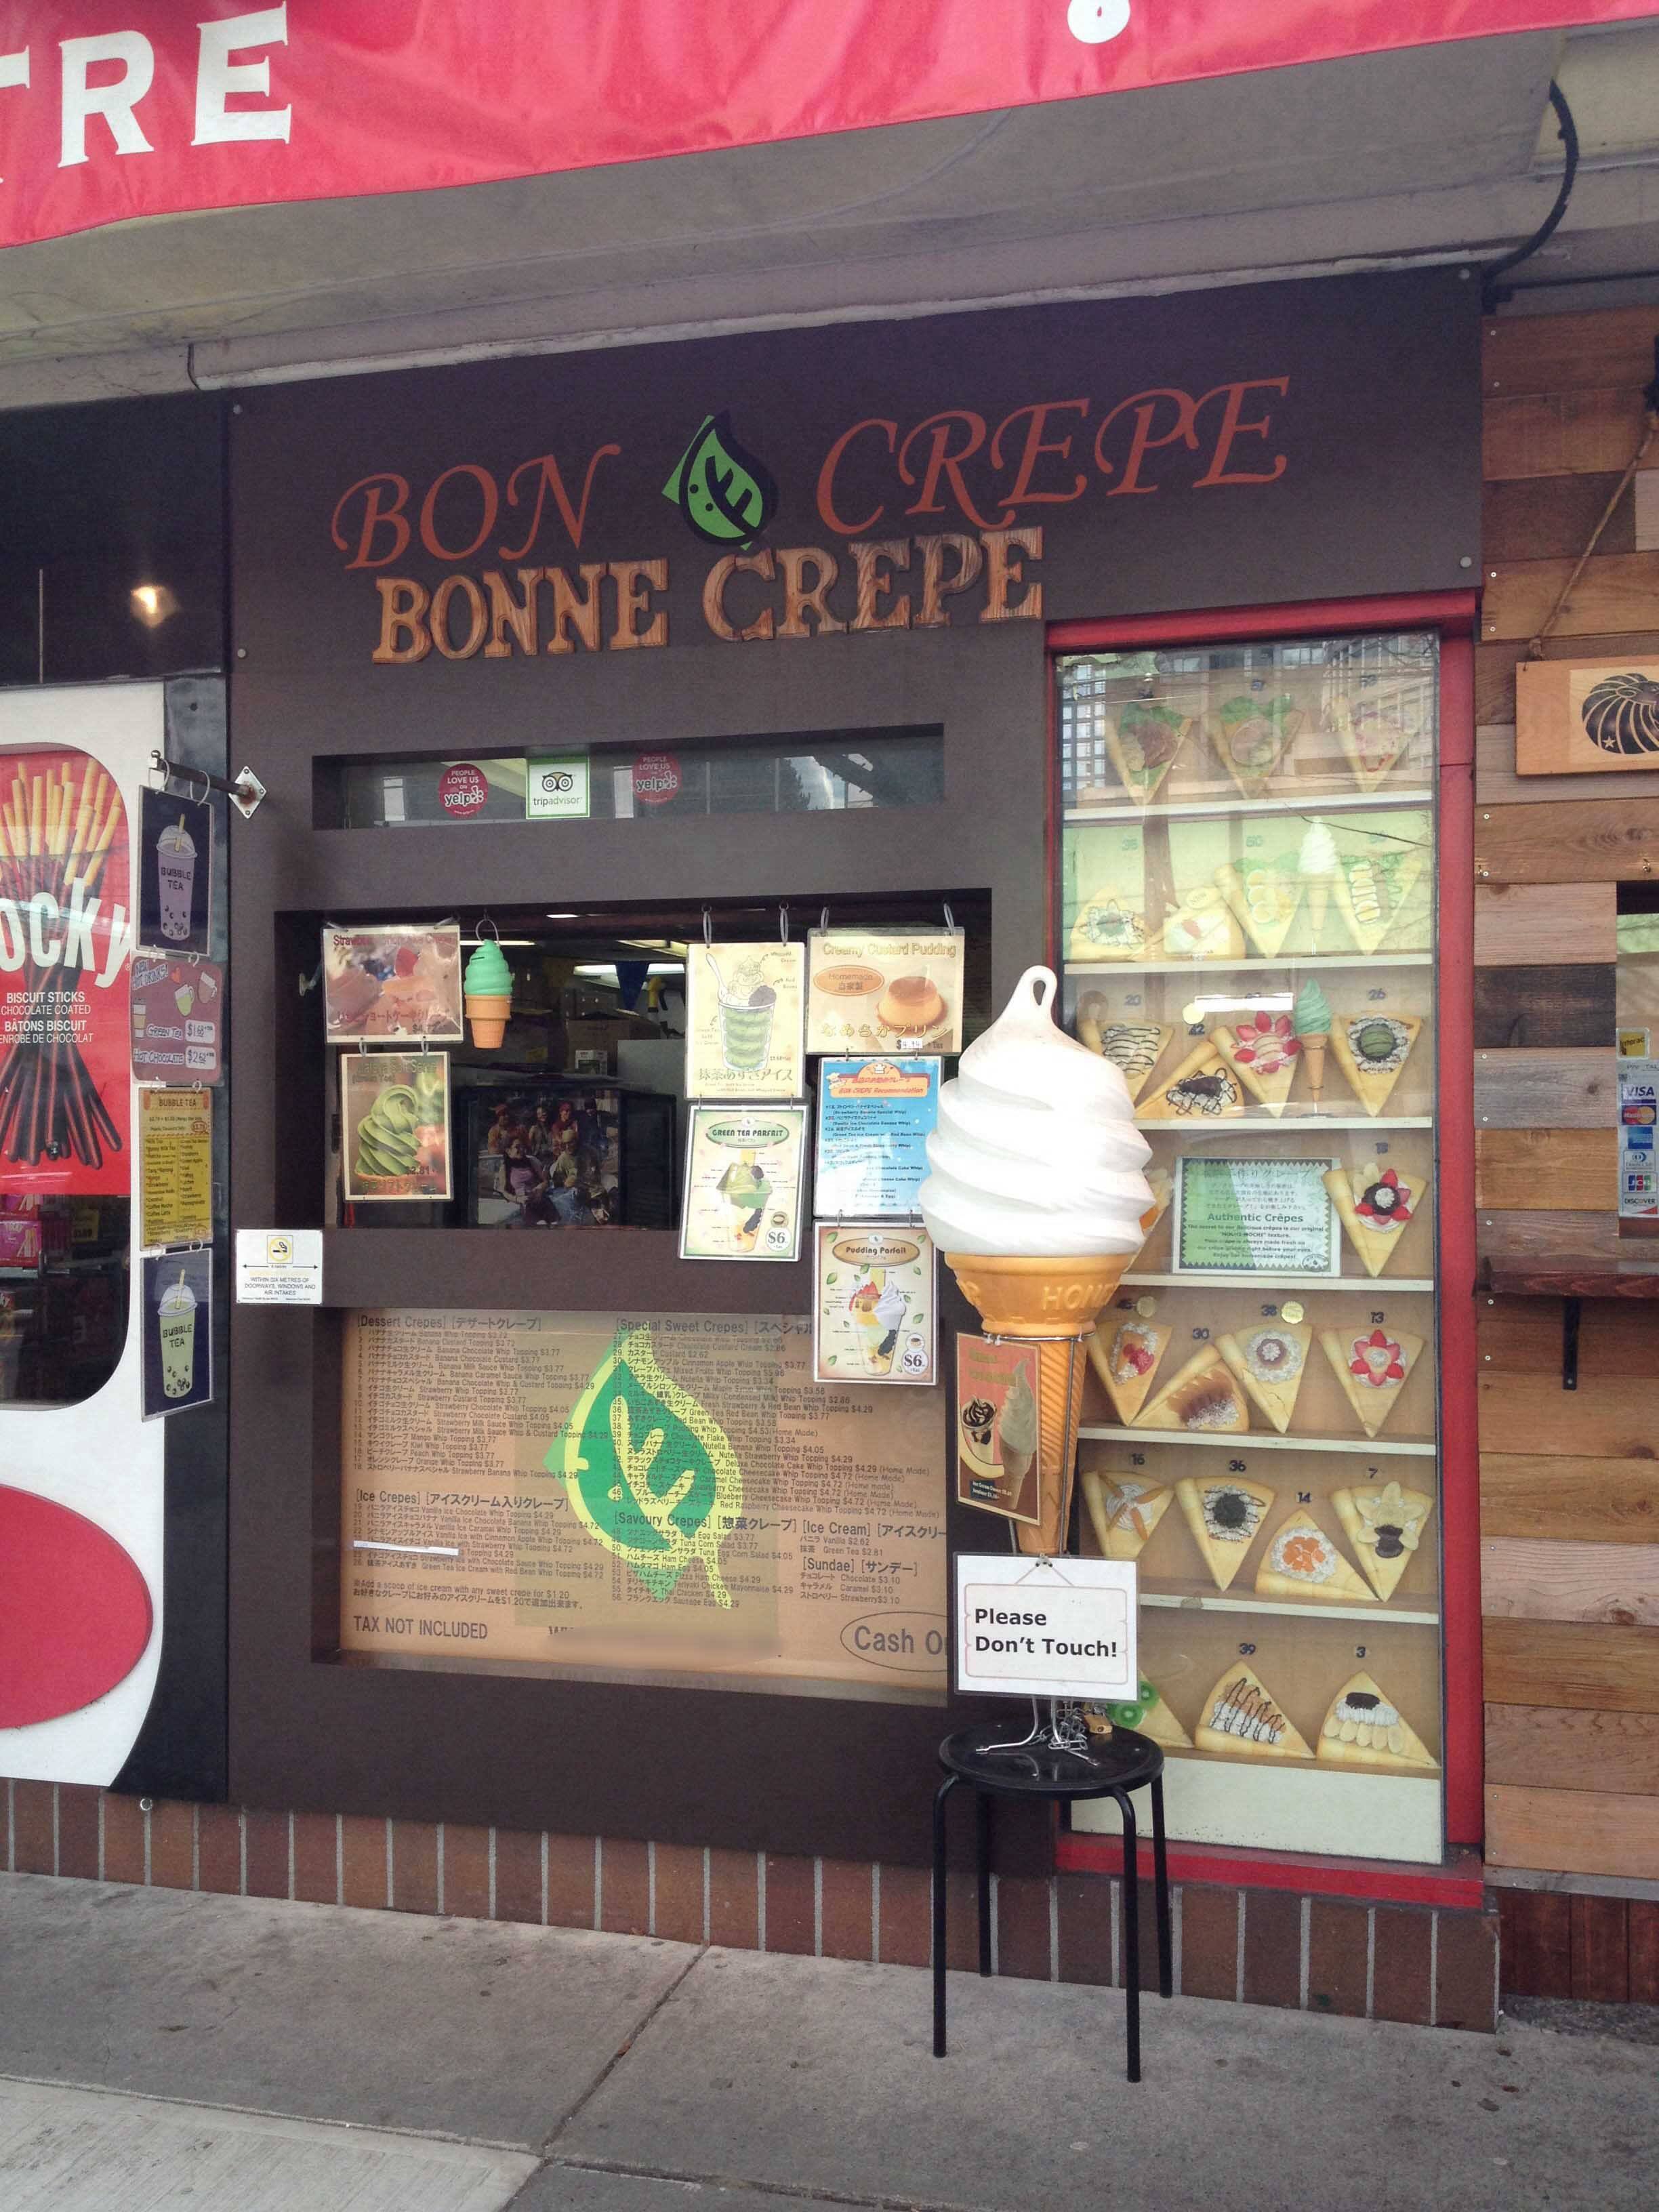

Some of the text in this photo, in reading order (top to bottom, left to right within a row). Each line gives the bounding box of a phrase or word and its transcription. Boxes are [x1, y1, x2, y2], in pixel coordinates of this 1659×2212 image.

[331, 375, 1290, 570] BON CREPE
[371, 526, 1045, 665] BONNE CREPE
[636, 777, 664, 792] yelp
[444, 792, 472, 807] yelp
[533, 796, 581, 807] tripadvisor
[160, 865, 192, 882] BUBBLE
[167, 880, 184, 892] TEA
[823, 943, 863, 957] Creamy
[912, 943, 956, 958] Pudding
[6, 991, 85, 1004] BISCUIT STICKS
[1368, 987, 1386, 1000] 26
[1, 1004, 91, 1015] CHOCOLATE COATED
[5, 1019, 87, 1032] BÂTONS BISCUIT
[147, 1024, 169, 1038] GREEN
[33, 1033, 44, 1044] DE
[47, 1032, 94, 1044] CHOCOLAT
[1626, 1086, 1654, 1097] VISA
[159, 1099, 184, 1107] BUBBLE
[1207, 1213, 1304, 1224] Authentic Crêpes
[846, 1246, 878, 1255] Pudding
[163, 1324, 192, 1340] BUBBLE
[665, 1320, 700, 1333] Sweet
[1191, 1328, 1210, 1340] 30
[169, 1338, 185, 1348] TEA
[1228, 1460, 1247, 1473] 36
[1368, 1467, 1378, 1479] 7
[1296, 1492, 1311, 1504] 14
[614, 1511, 663, 1526] [Savoury
[698, 1531, 710, 1540] Egg
[829, 1521, 871, 1537] Cream]
[802, 1556, 855, 1574] [Sundae]
[975, 1608, 1047, 1626] Please
[353, 1616, 489, 1640] TAX NOT INCLUDED
[854, 1625, 915, 1654] Cash
[975, 1635, 1117, 1658] Don't Touch!
[1239, 1642, 1256, 1656] 39
[1355, 1646, 1366, 1659] 3
